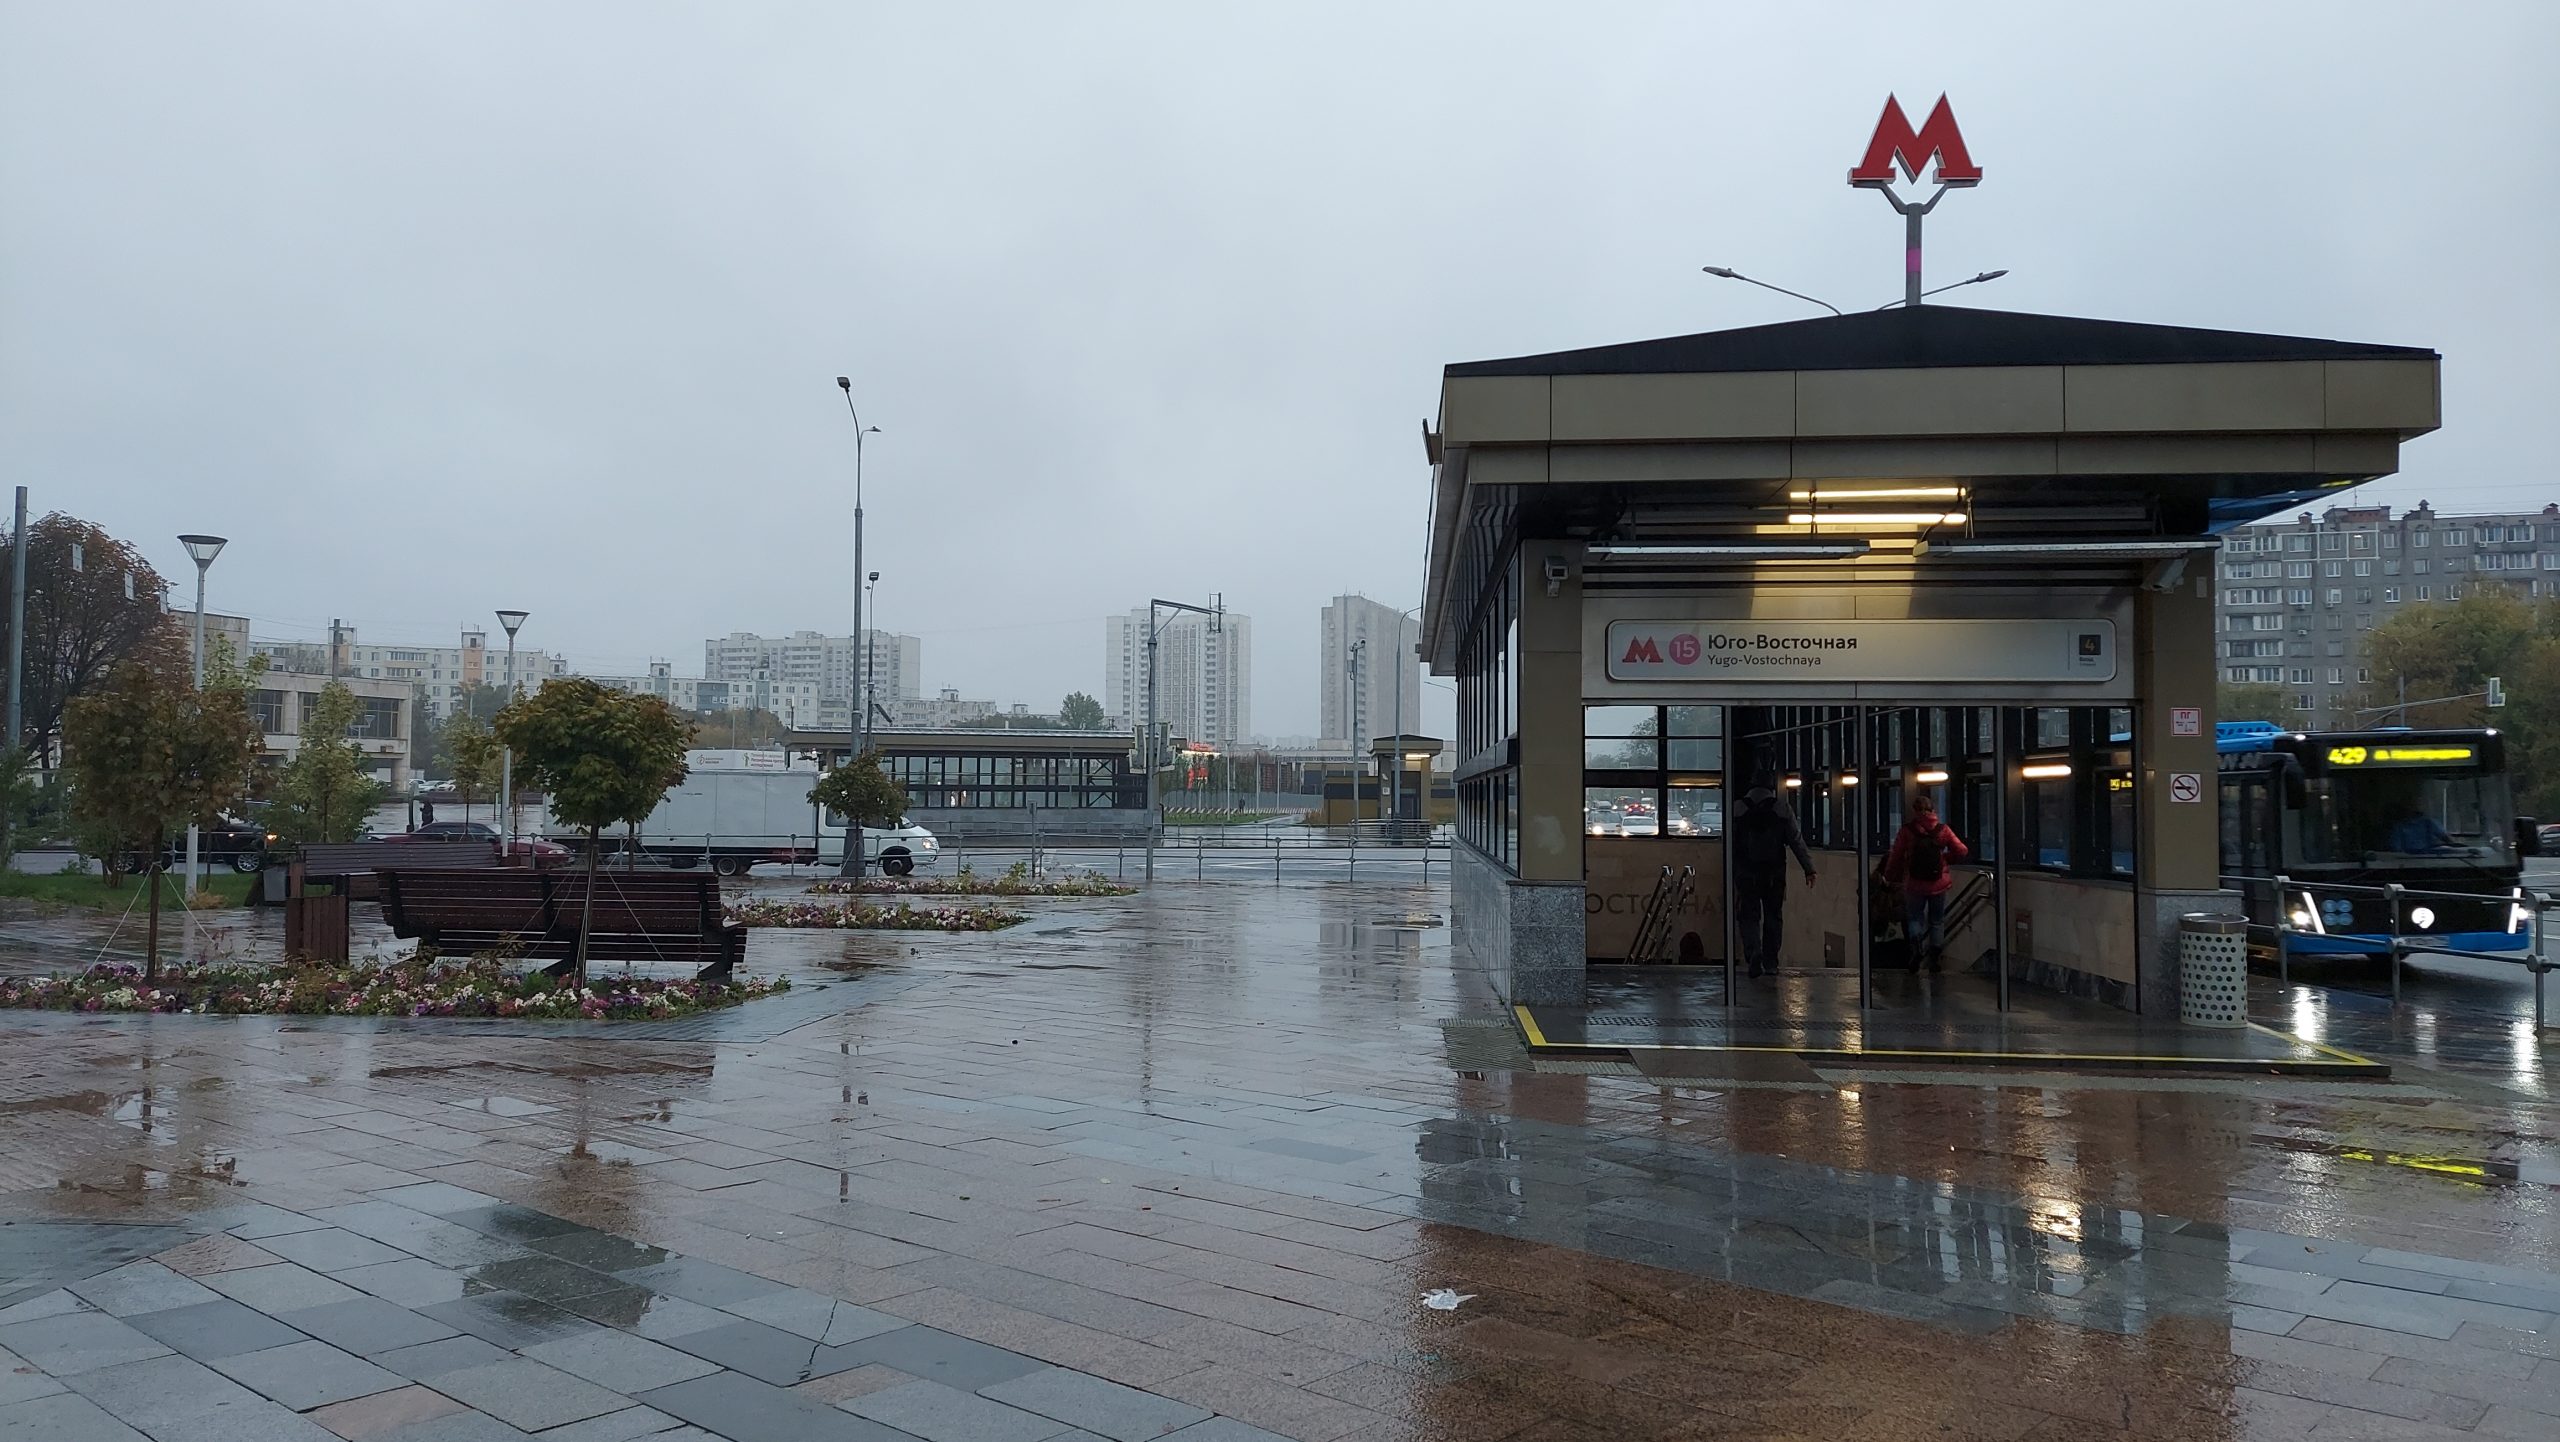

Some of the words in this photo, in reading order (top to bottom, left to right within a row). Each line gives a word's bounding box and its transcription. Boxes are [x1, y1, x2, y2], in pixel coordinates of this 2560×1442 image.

[1848, 91, 1983, 184] М
[1674, 640, 1696, 658] 15
[1708, 634, 1858, 650] Юго-Восточная
[1707, 654, 1821, 668] Yugo-Vostochnaya
